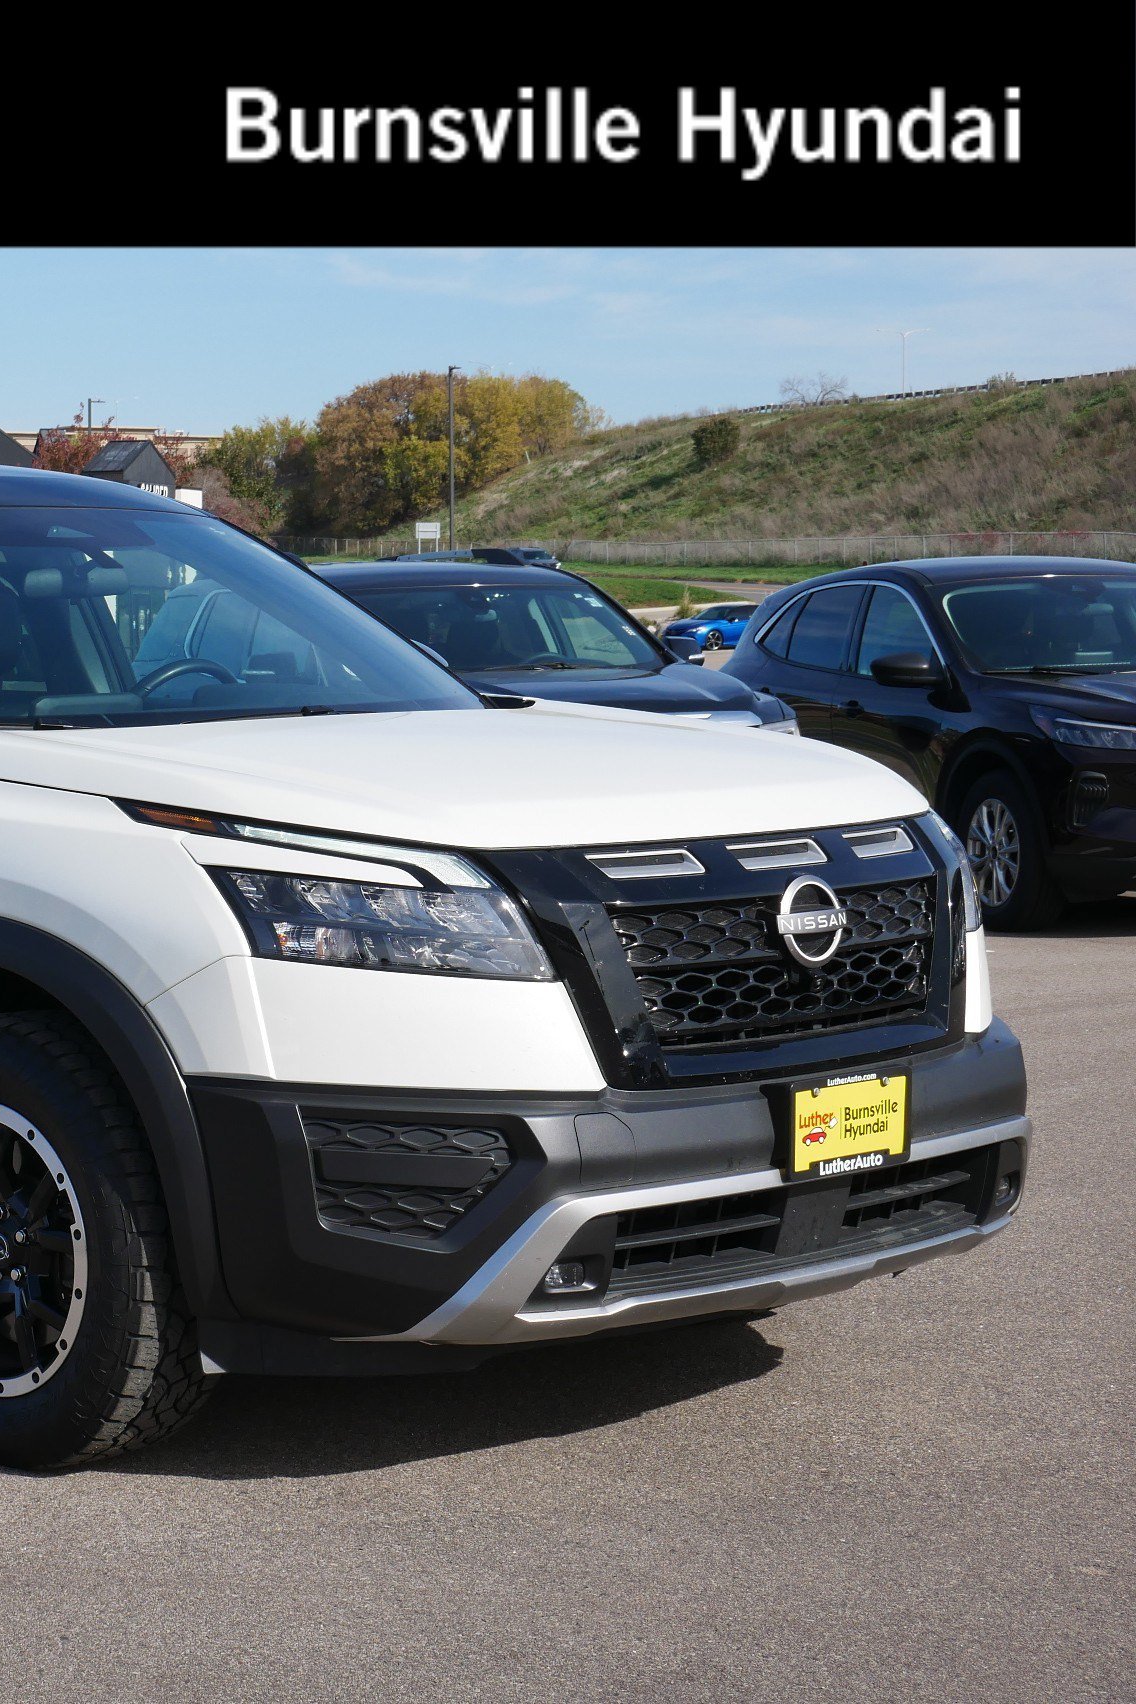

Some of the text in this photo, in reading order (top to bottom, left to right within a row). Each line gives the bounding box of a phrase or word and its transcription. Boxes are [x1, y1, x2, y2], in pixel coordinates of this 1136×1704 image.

[781, 912, 847, 931] NISSAN
[827, 1073, 877, 1087] LutherAuto.com
[799, 1111, 834, 1129] Luther
[844, 1099, 898, 1122] Burnsville
[844, 1117, 889, 1140] Hyundai
[819, 1153, 884, 1176] LutherAuto
